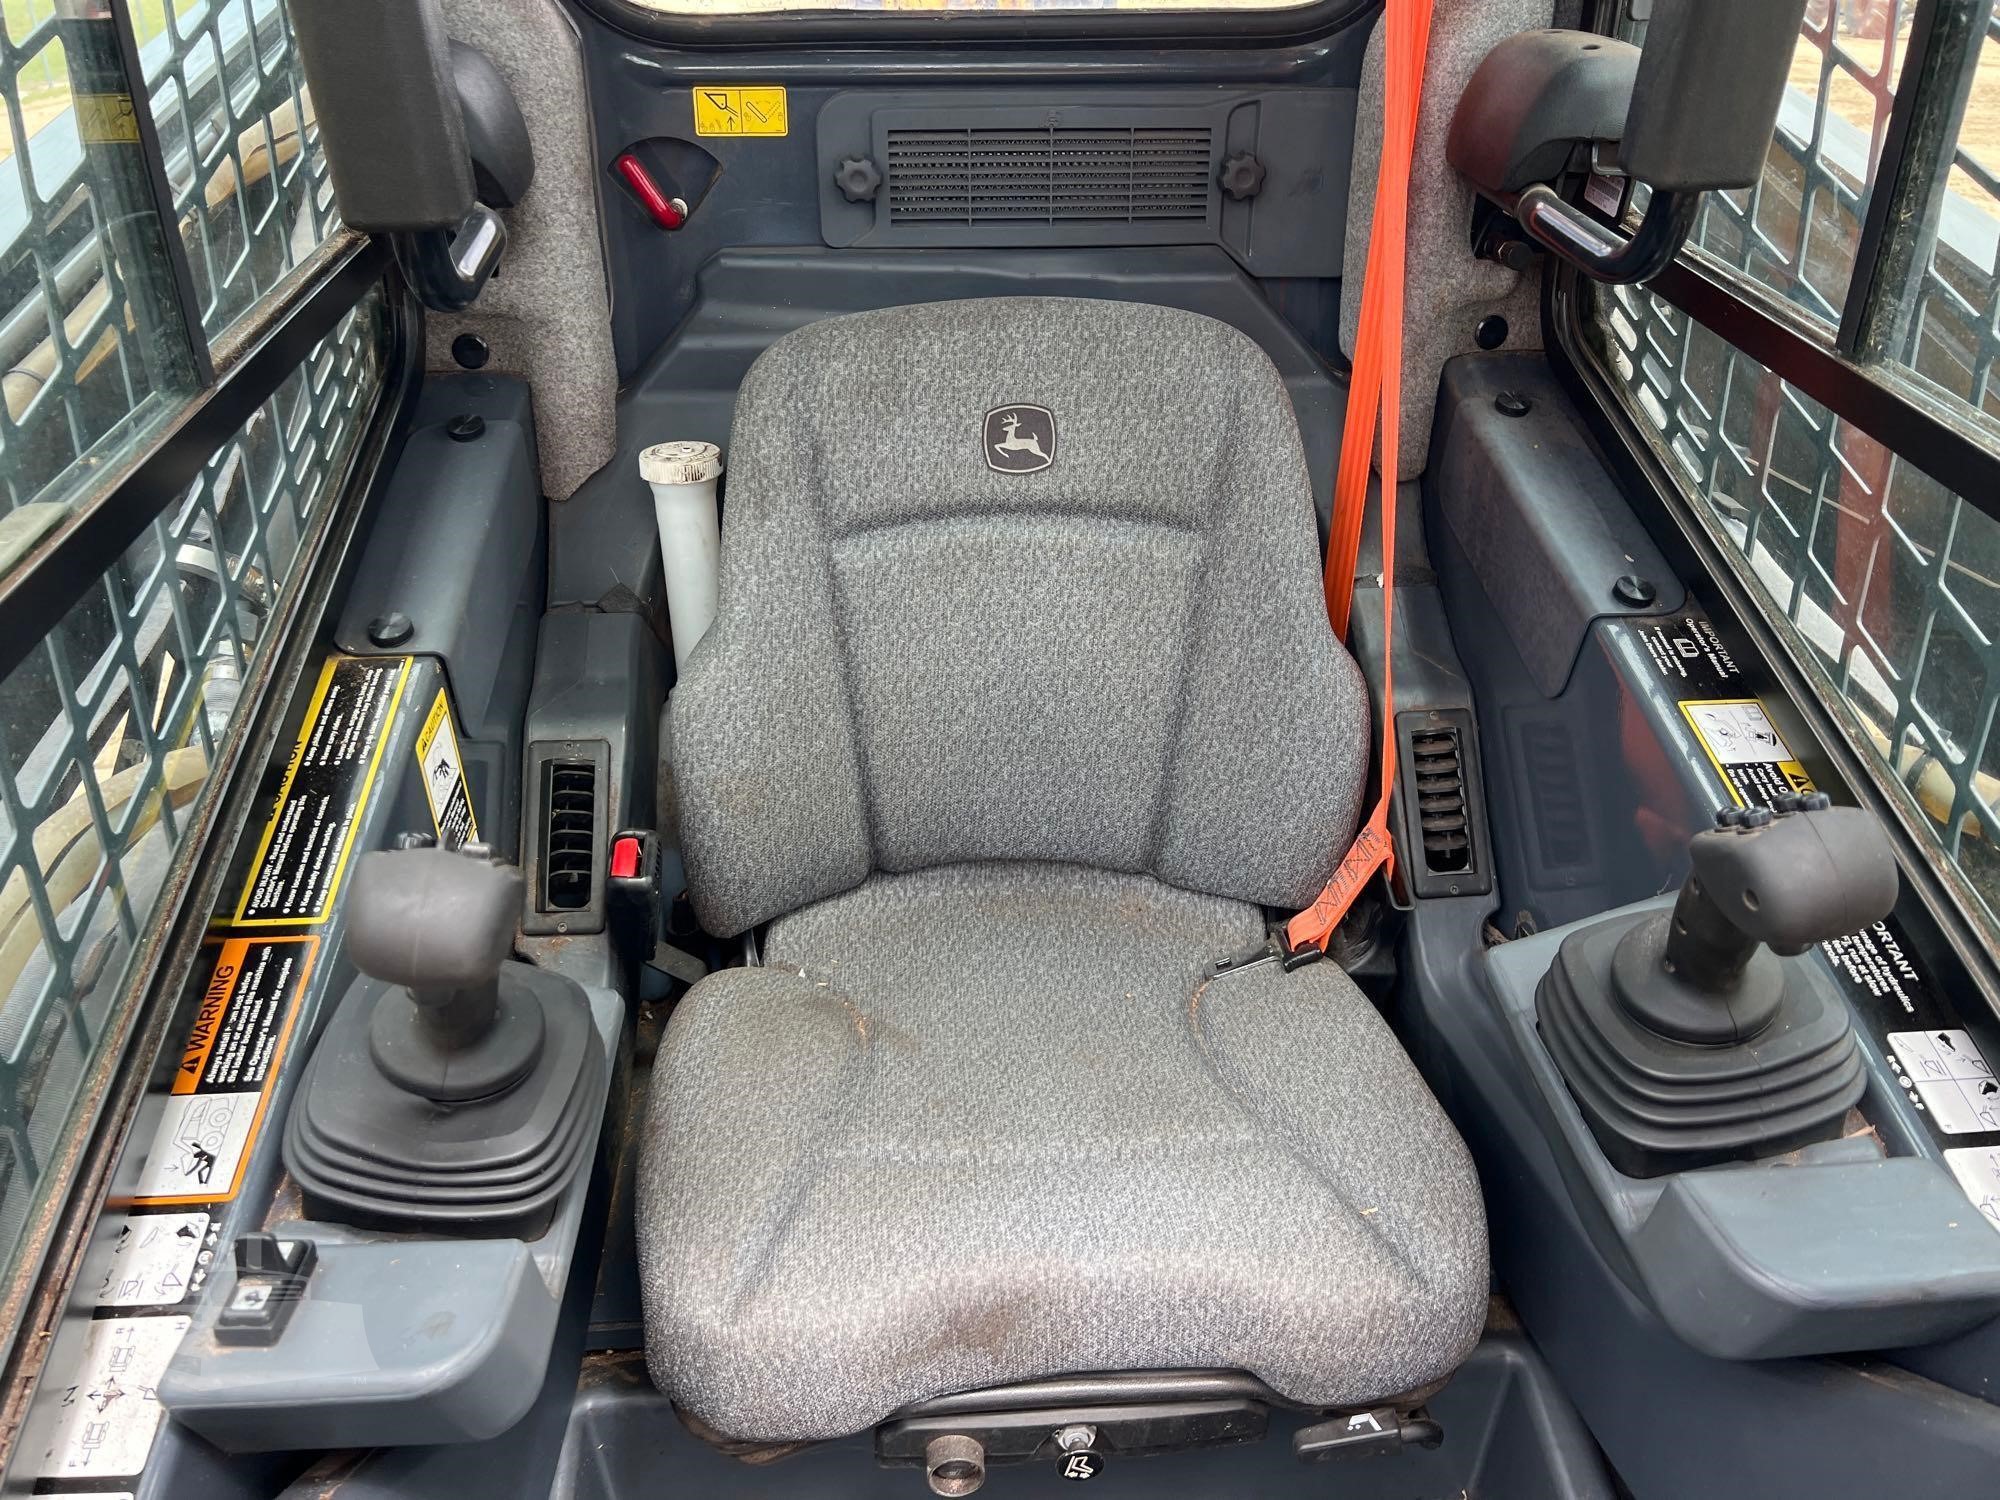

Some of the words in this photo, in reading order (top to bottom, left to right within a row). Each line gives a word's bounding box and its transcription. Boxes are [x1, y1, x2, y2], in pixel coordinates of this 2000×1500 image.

[1686, 618, 1711, 652] Operator's
[1708, 653, 1728, 678] Manual
[1699, 621, 1740, 674] IMPORTANT
[1746, 768, 1761, 784] Avoid
[1763, 763, 1784, 785] Avoid
[304, 827, 319, 850] function
[252, 888, 265, 908] AVOID
[259, 864, 273, 887] INJURY
[269, 844, 281, 859] Read
[276, 832, 285, 843] and
[281, 800, 297, 831] understand
[260, 876, 278, 908] Operator's
[272, 853, 286, 875] Manual
[280, 834, 293, 852] before
[289, 806, 305, 833] operating
[298, 795, 307, 805] this
[301, 852, 310, 863] and
[313, 847, 327, 870] devices
[291, 864, 306, 888] location
[307, 871, 320, 889] safety
[284, 889, 297, 907] Know
[300, 890, 313, 906] Keep
[316, 889, 328, 905] Keep
[262, 946, 272, 960] with
[1851, 936, 1890, 993] temperatures
[1875, 955, 1888, 966] of
[251, 962, 266, 990] machine
[277, 958, 293, 989] complete
[1841, 954, 1862, 984] before
[1848, 948, 1861, 964] run
[1858, 965, 1869, 975] at
[1864, 975, 1882, 997] slow
[238, 972, 253, 993] before
[271, 989, 282, 999] for
[1881, 966, 1914, 1013] hydraulics
[186, 965, 235, 1053] WARNING
[232, 995, 245, 1009] lock
[245, 991, 256, 1004] this
[236, 1006, 251, 1031] around
[262, 1001, 278, 1026] Manual
[216, 1032, 231, 1055] install
[233, 1032, 241, 1040] or
[240, 1023, 255, 1044] boom
[229, 1041, 238, 1051] on
[232, 1045, 246, 1068] loader
[248, 1027, 269, 1065] Operator's
[206, 1056, 223, 1083] Always
[218, 1052, 236, 1083] working
[227, 1070, 238, 1082] the
[243, 1067, 255, 1081] See
